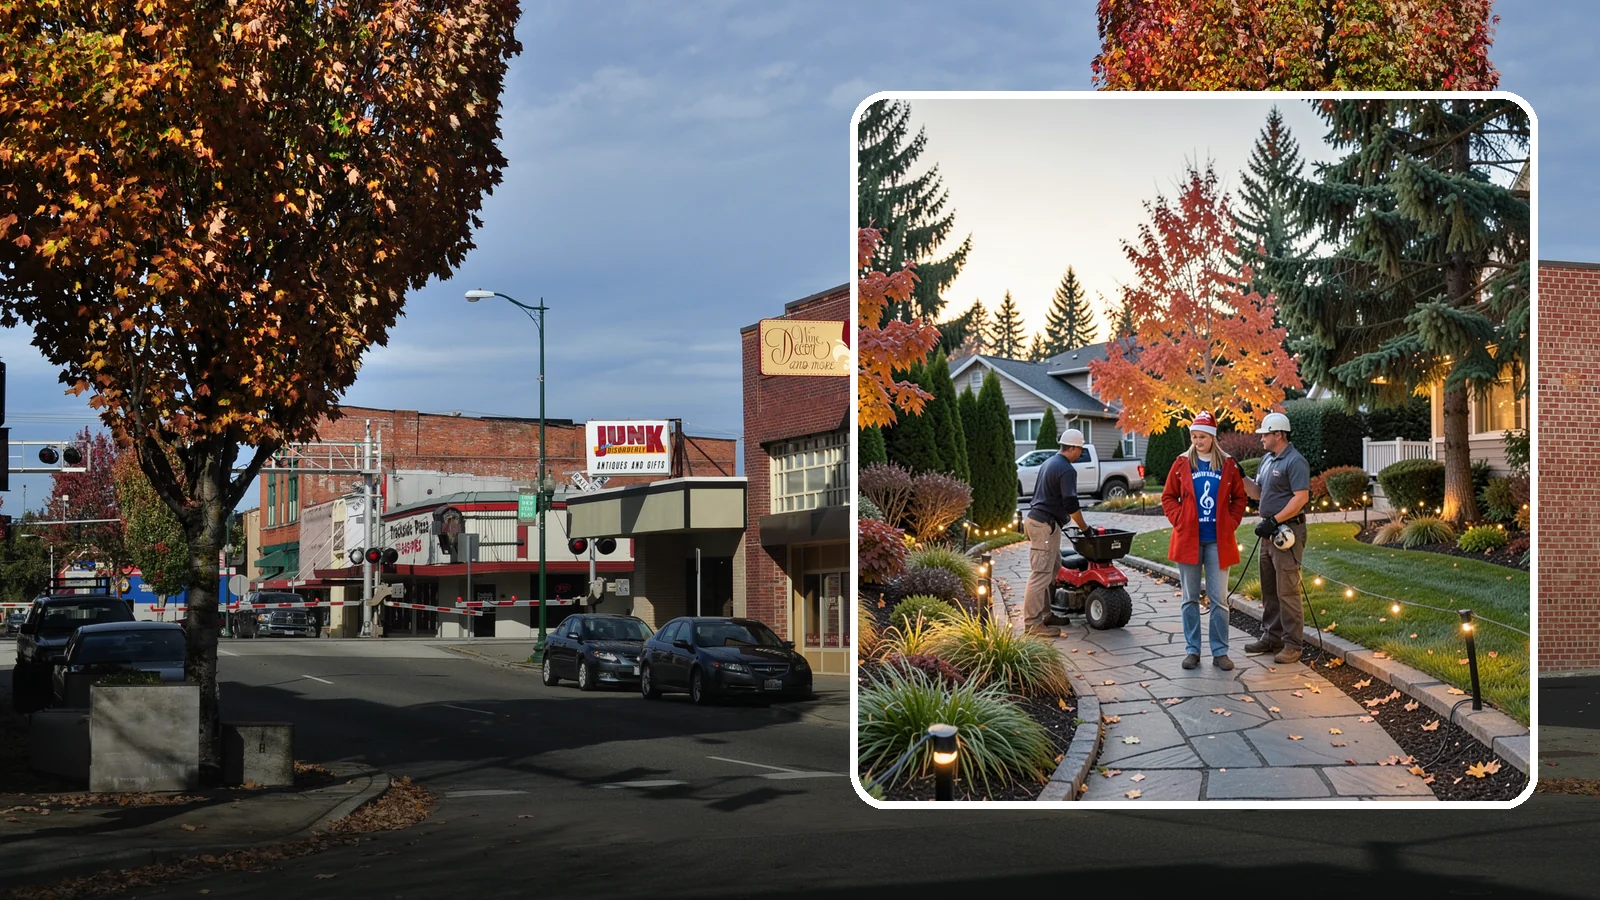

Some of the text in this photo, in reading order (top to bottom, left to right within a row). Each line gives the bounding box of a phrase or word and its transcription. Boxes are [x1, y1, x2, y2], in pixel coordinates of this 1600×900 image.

[596, 425, 664, 457] JUNK
[596, 460, 665, 470] ANTIQUES AND GIFTS
[415, 520, 429, 534] Pizza
